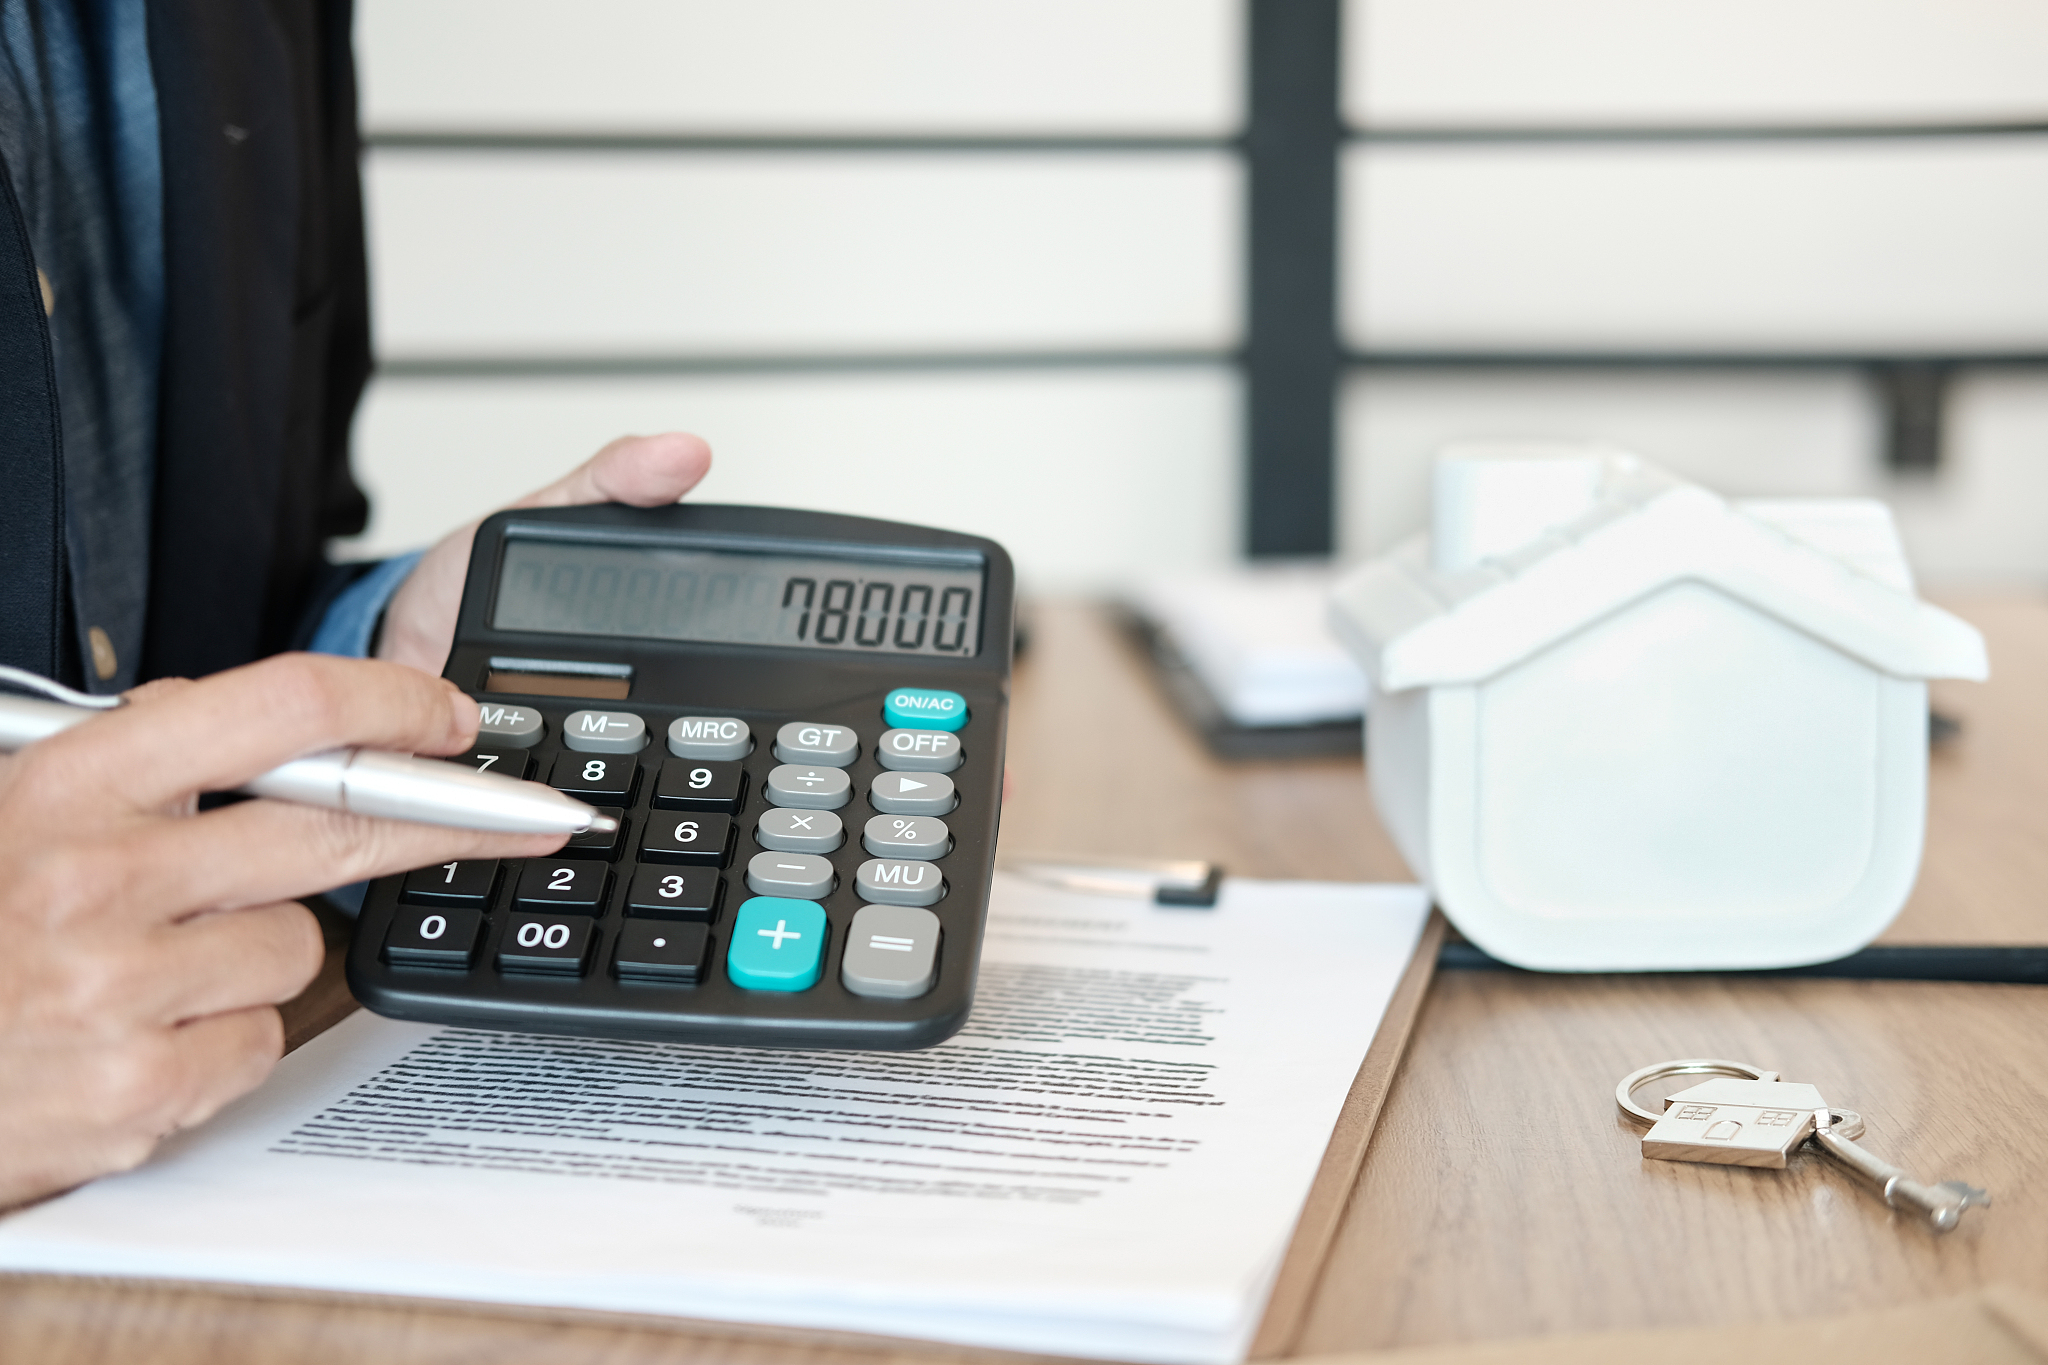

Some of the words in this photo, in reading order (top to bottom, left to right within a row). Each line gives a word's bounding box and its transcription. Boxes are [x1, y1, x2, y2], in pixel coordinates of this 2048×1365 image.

[894, 695, 955, 711] ON/AC
[480, 706, 525, 726] M+
[681, 721, 738, 740] MRC
[798, 728, 842, 747] GT
[892, 733, 950, 752] OFF
[476, 754, 499, 774] 7
[582, 760, 607, 781] 8
[688, 768, 713, 789] 9
[674, 821, 699, 843] 6
[892, 819, 917, 840] %
[442, 861, 458, 884] 1
[547, 868, 576, 891] 2
[874, 863, 925, 885] MU
[658, 875, 684, 898] 3
[419, 915, 447, 940] 0
[516, 922, 571, 949] 00
[869, 934, 914, 952] =
